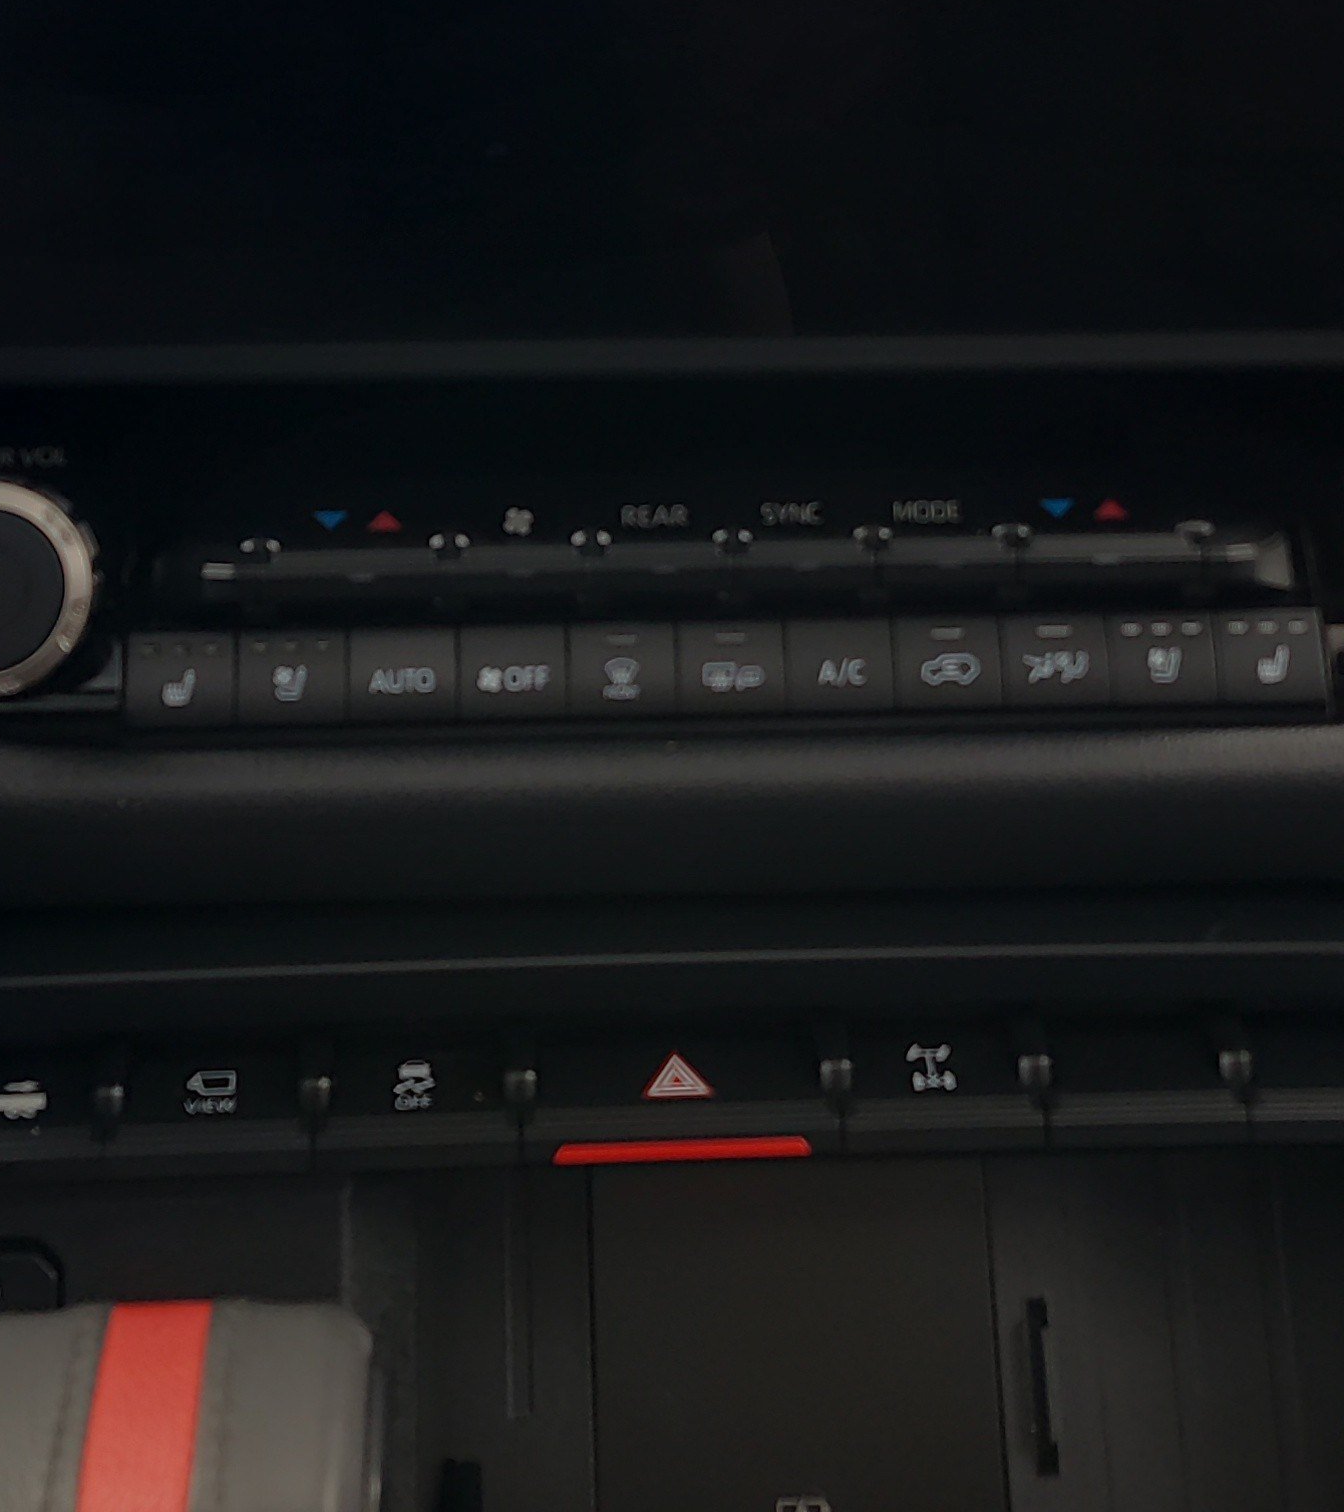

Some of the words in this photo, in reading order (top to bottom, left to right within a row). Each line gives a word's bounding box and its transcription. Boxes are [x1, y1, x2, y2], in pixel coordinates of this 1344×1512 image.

[620, 504, 689, 528] REAR
[760, 501, 824, 526] SYNC
[892, 499, 962, 524] MODE
[368, 667, 437, 694] AUTO
[503, 664, 550, 692] OFF
[817, 656, 868, 688] A/C
[182, 1096, 238, 1115] VIEW
